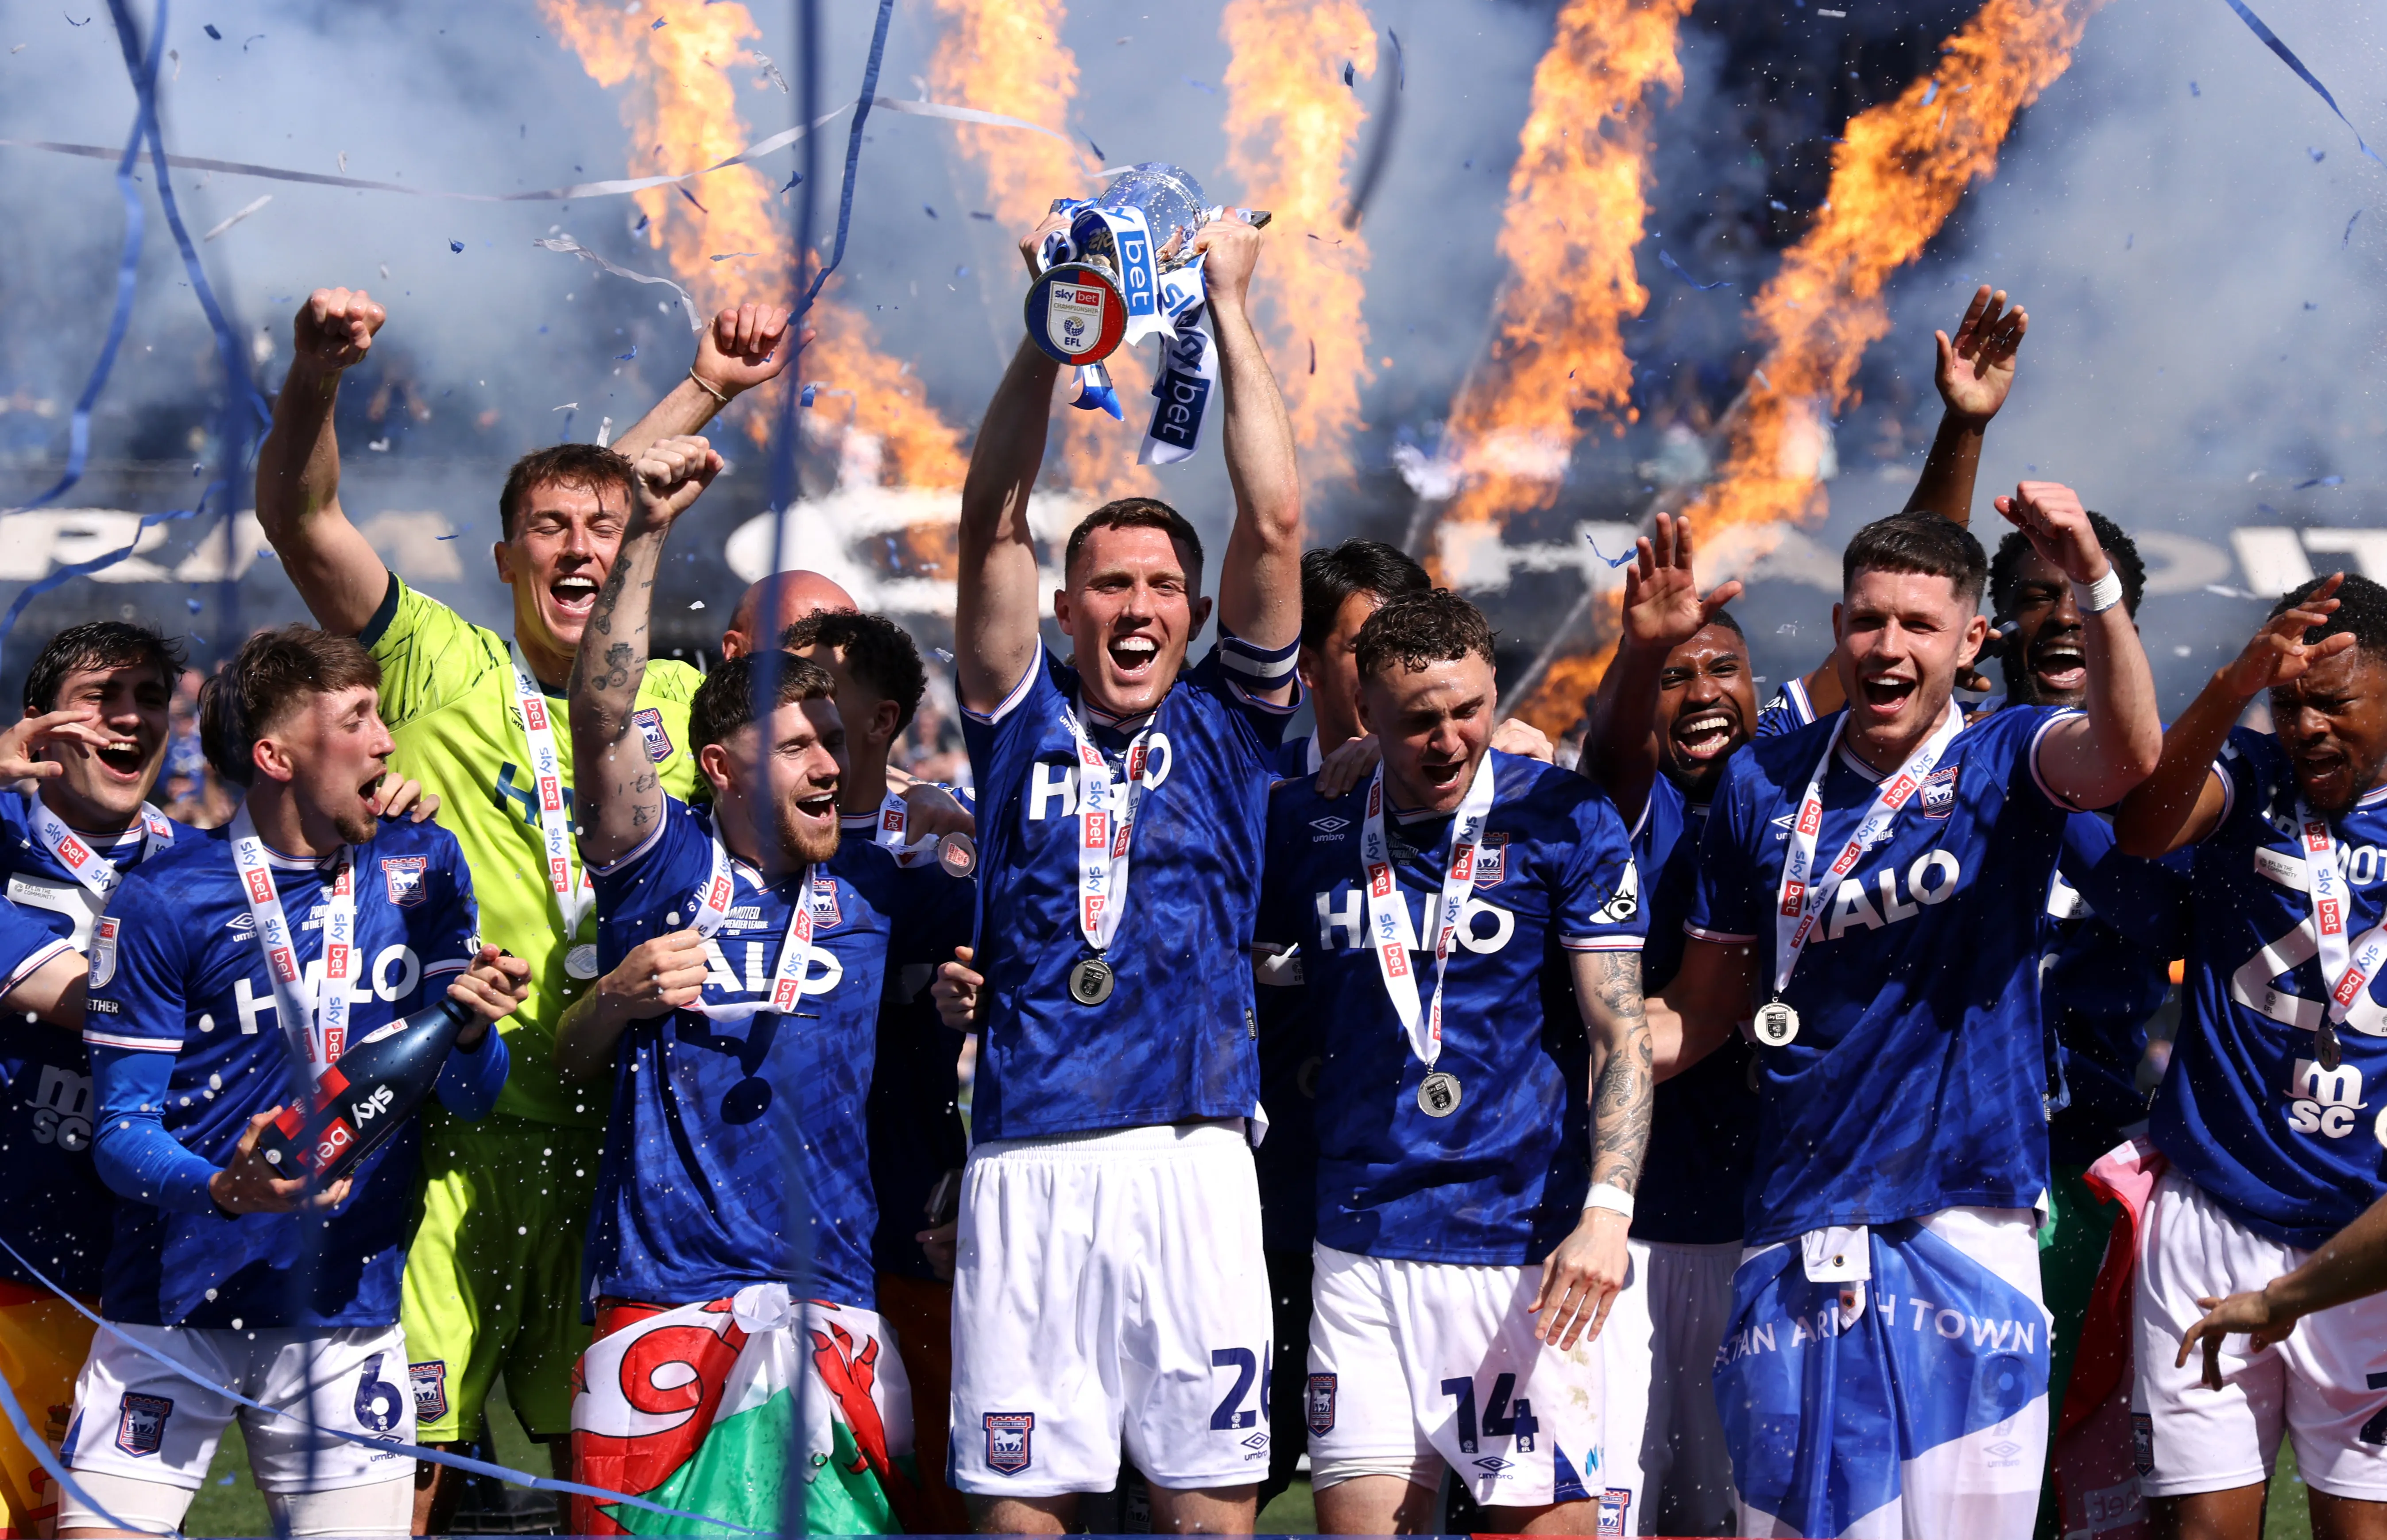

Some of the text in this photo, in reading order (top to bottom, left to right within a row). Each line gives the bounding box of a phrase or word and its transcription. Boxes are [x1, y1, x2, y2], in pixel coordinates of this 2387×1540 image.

[1125, 240, 1148, 308] bet
[1054, 303, 1098, 313] CHAMPIONSHIP
[1055, 289, 1097, 303] sky bet
[1064, 337, 1081, 347] EFL
[1162, 380, 1205, 439] bet
[1085, 749, 1102, 766] bet
[517, 674, 565, 890] sky bet sky bet sky bet
[1087, 782, 1105, 810] sky
[1116, 750, 1147, 855] bet sky bet
[888, 814, 902, 831] bet
[1090, 816, 1104, 844] bet
[1459, 816, 1478, 842] sky
[1312, 832, 1345, 843] umbro
[1366, 832, 1381, 860] sky
[1792, 754, 1933, 944] sky bet sky bet sky bet
[45, 823, 116, 892] sky bet sky
[1455, 848, 1472, 878] bet
[1786, 804, 1822, 913] bet sky bet
[1086, 866, 1104, 892] sky
[1373, 866, 1387, 894] bet
[2267, 866, 2297, 878] COMMUNITY
[2310, 823, 2338, 930] bet sky bet
[24, 890, 56, 900] COMMUNITY
[713, 880, 730, 908] bet
[241, 842, 258, 866] sky
[251, 871, 268, 901] bet
[265, 919, 282, 945] sky
[275, 950, 290, 978] bet
[1445, 896, 1460, 923] sky
[721, 920, 747, 929] PREMIER
[800, 914, 809, 938] bet
[1380, 913, 1396, 940] sky
[1438, 927, 1454, 959] bet
[326, 867, 348, 1060] bet sky bet sky bet
[784, 952, 803, 977] sky
[1387, 945, 1404, 975] bet
[2337, 945, 2378, 1002] sky bet
[2264, 1005, 2273, 1014] EFL
[352, 1084, 394, 1129] sky
[313, 1126, 354, 1169] bet
[1909, 1298, 2034, 1354] TOWN
[355, 1354, 402, 1432] 6
[1441, 1373, 1540, 1454] 14
[1245, 1450, 1267, 1461] umbro
